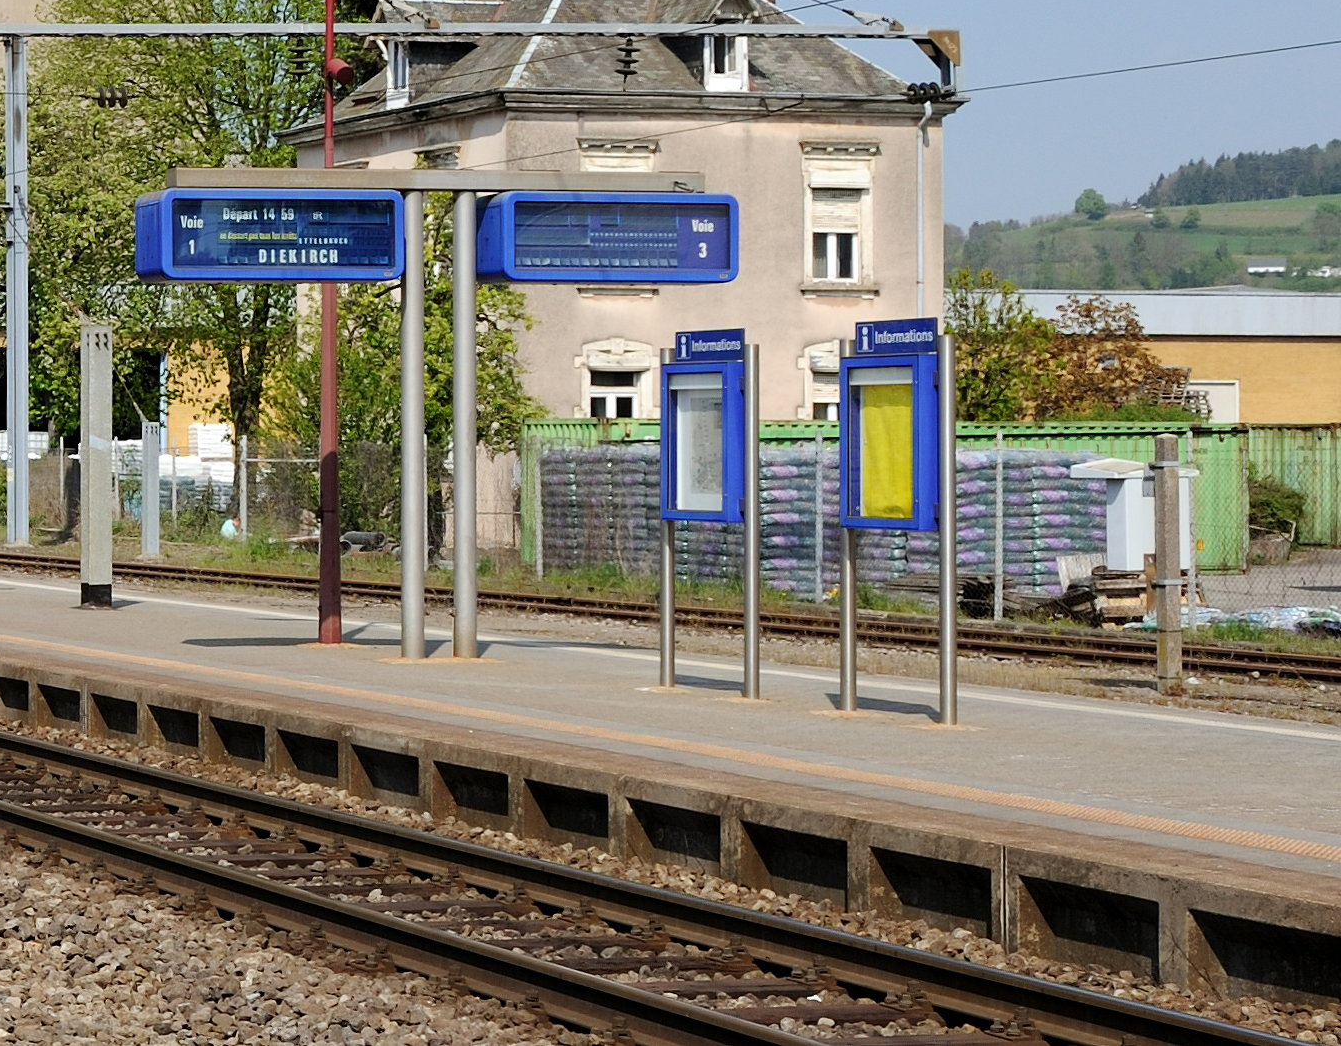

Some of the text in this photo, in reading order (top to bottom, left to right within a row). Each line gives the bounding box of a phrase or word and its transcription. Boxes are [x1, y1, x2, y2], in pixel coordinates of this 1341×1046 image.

[263, 208, 276, 221] 14
[180, 215, 204, 229] Voie
[691, 219, 715, 233] Voie
[188, 239, 195, 255] 1
[698, 242, 708, 259] 3
[258, 249, 339, 264] DIEKIRCH
[875, 328, 934, 345] Informations
[691, 338, 742, 352] Informations
